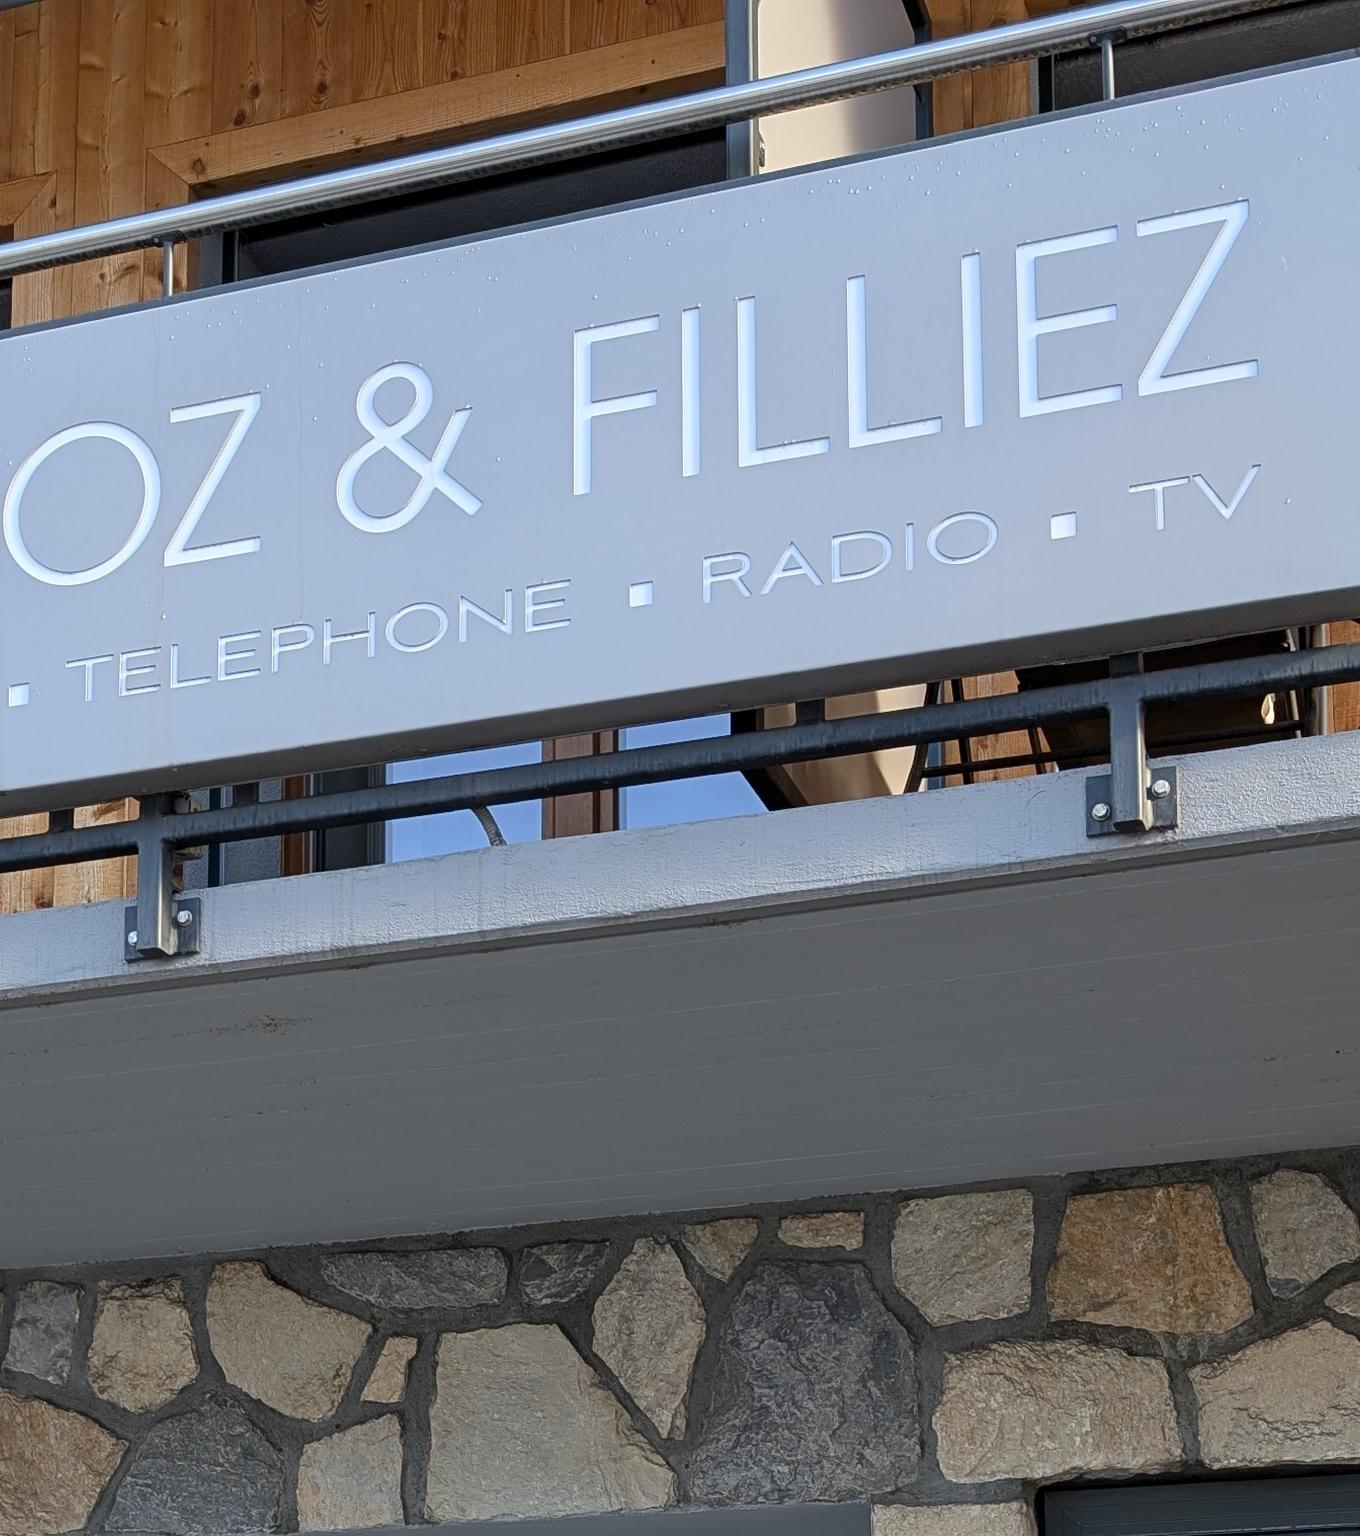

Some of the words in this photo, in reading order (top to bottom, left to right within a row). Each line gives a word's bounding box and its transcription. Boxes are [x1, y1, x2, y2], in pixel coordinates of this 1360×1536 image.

[337, 361, 482, 533] &
[573, 199, 1258, 496] FILLIEZ
[66, 580, 573, 703] TELEPHONE
[702, 512, 999, 604] RADIO
[1128, 465, 1260, 531] TV
